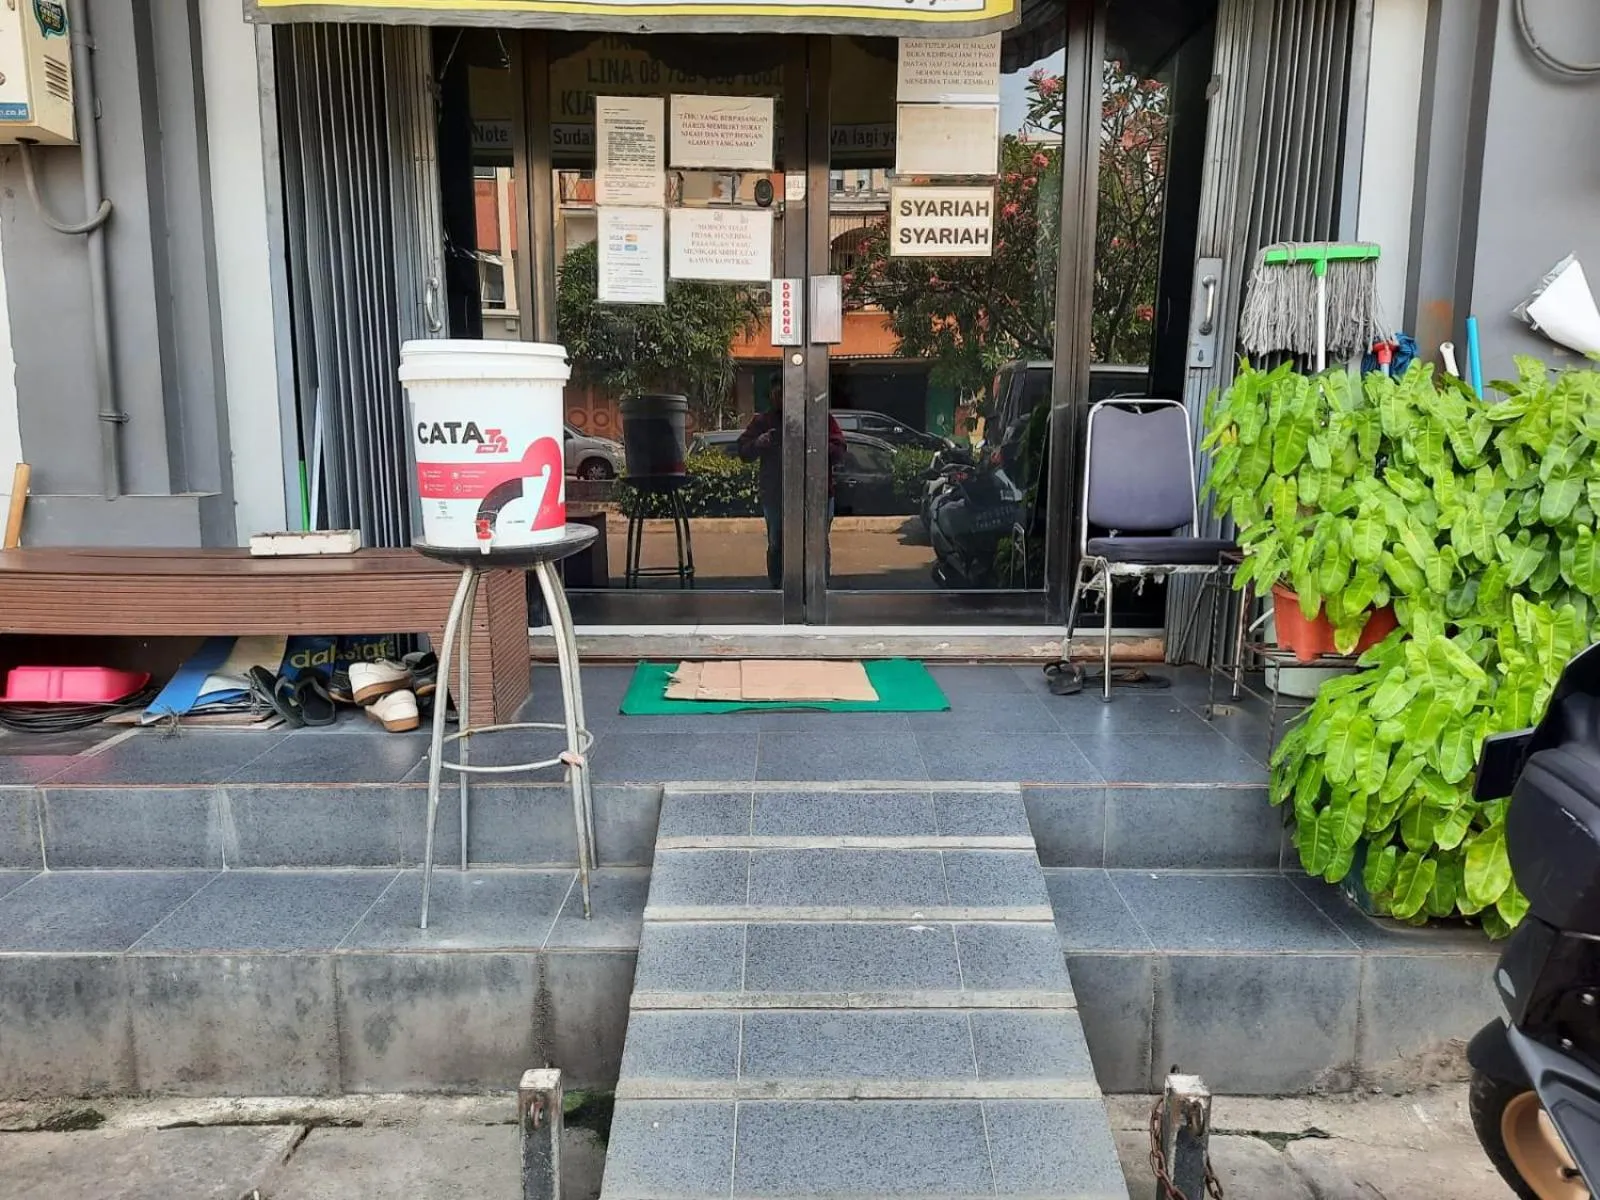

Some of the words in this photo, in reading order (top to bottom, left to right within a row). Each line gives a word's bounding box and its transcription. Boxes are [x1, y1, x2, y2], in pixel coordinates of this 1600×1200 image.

[587, 58, 634, 84] LINA
[472, 124, 509, 142] Note
[900, 200, 989, 217] SYARIAH
[899, 227, 989, 244] SYARIAH
[782, 281, 791, 335] DORONG
[417, 421, 485, 444] CATA
